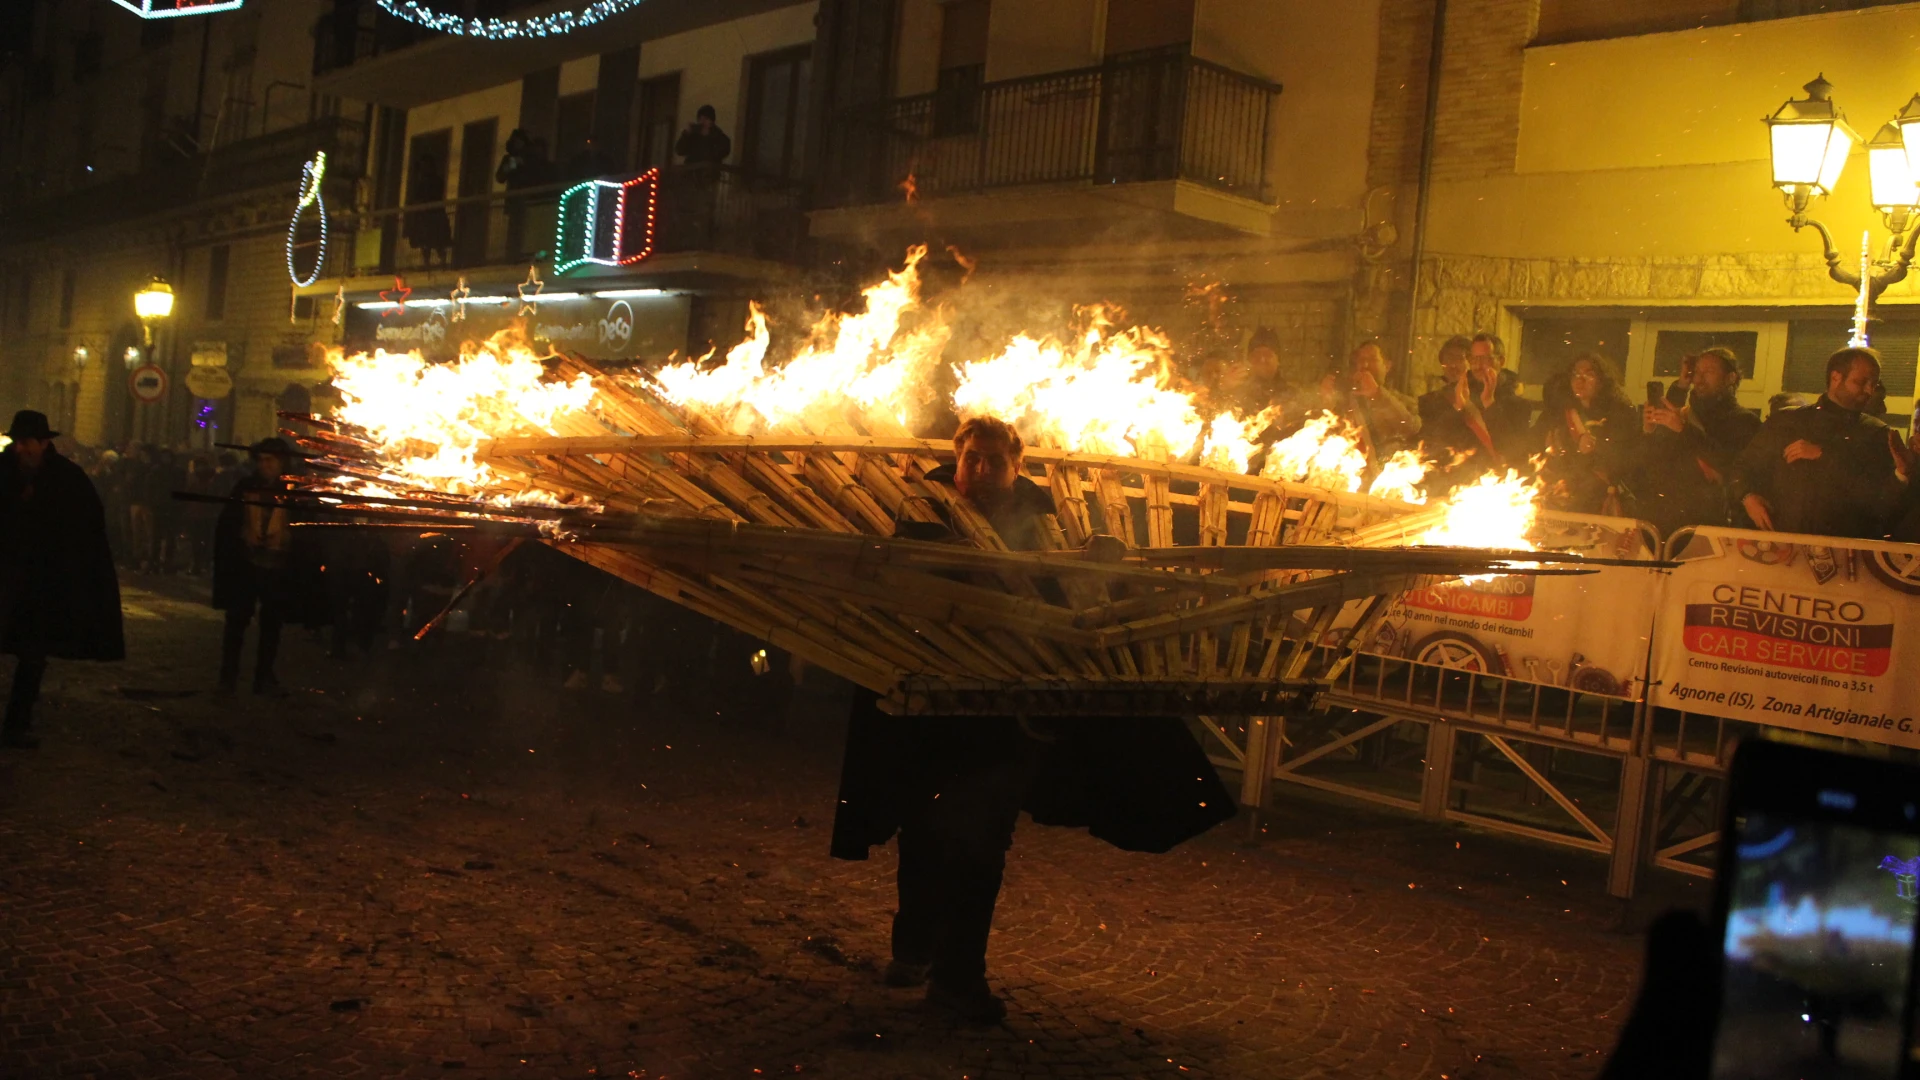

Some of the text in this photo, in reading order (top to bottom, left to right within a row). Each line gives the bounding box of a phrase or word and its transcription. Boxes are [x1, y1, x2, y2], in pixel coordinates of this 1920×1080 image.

[1404, 590, 1514, 617] UTORICAMBI
[1712, 583, 1866, 623] CENTRO
[1414, 611, 1433, 623] anni
[1435, 614, 1448, 625] nel
[1449, 617, 1480, 630] mondo
[1482, 622, 1496, 632] dei
[1498, 623, 1534, 639] ricambi!
[1710, 606, 1861, 648] REVISIONI
[1698, 631, 1868, 674] CAR SERVICE
[1688, 657, 1874, 693] Centro Revisioni autoveicoli fino a 3,5 t
[1669, 682, 1726, 705] Agnone
[1728, 690, 1756, 710] (IS),
[1762, 696, 1803, 716] Zona
[1804, 703, 1894, 731] Artigianale
[1897, 716, 1914, 734] G.
